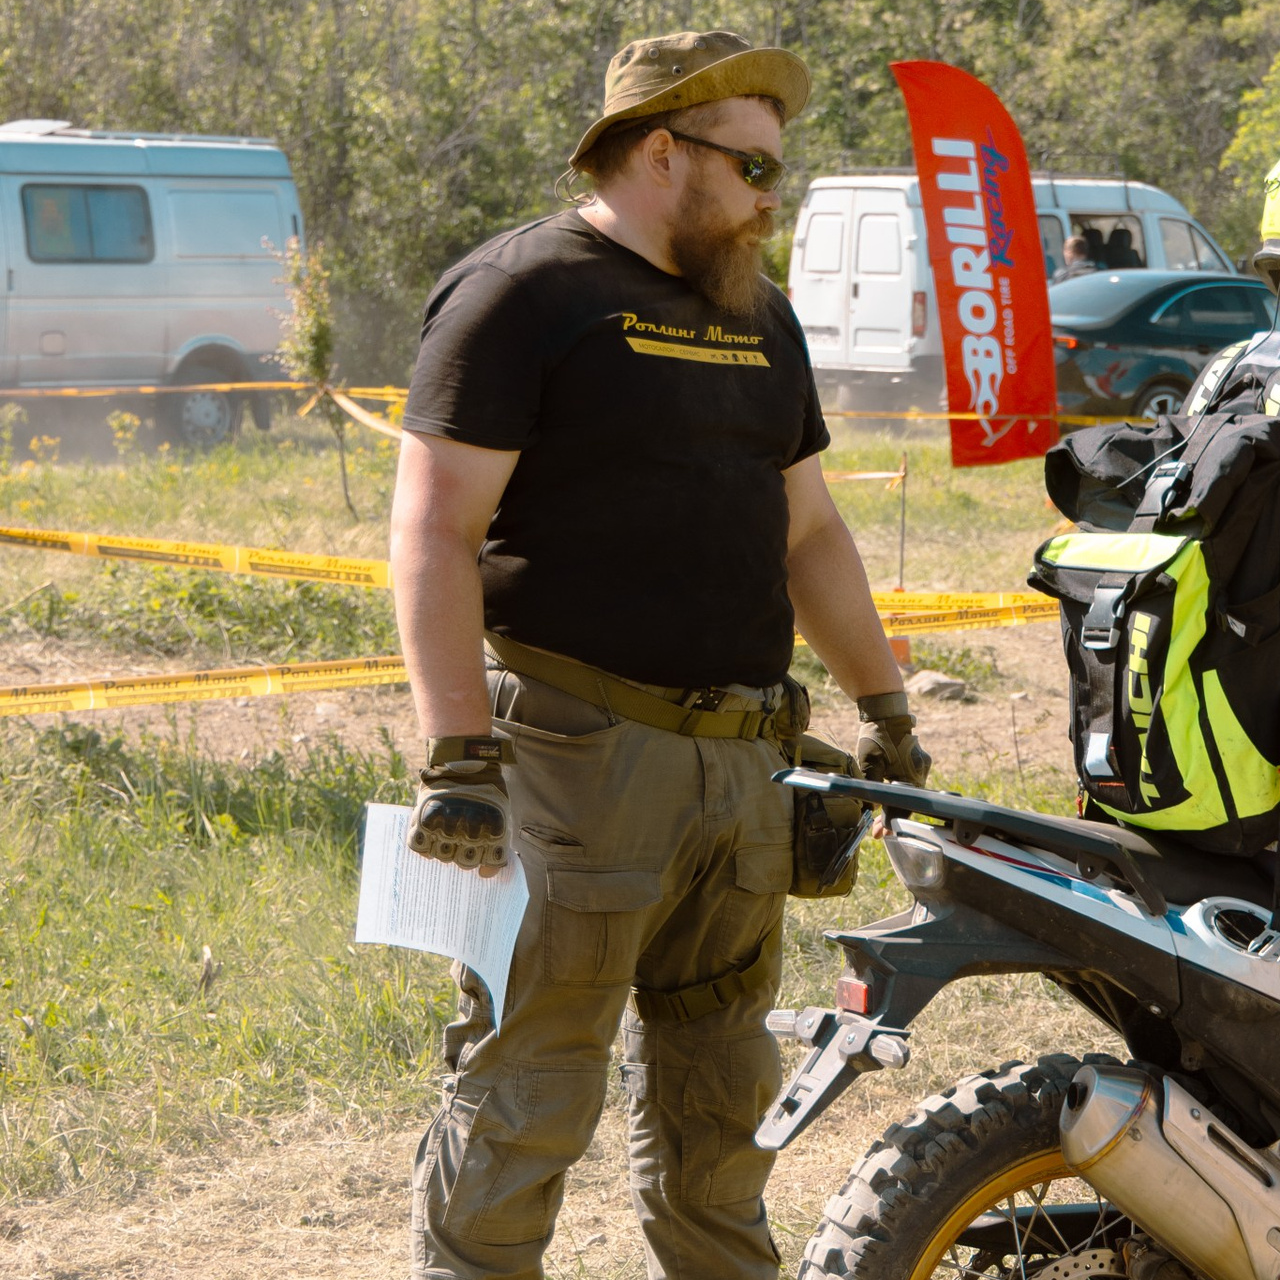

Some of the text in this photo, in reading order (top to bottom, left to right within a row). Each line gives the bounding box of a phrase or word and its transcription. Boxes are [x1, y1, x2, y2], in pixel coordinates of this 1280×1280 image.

[980, 125, 1015, 269] Racing
[621, 312, 765, 346] Роллинг Мото
[931, 137, 1005, 403] BORILLI
[999, 276, 1018, 375] OFF ROAD TIRE
